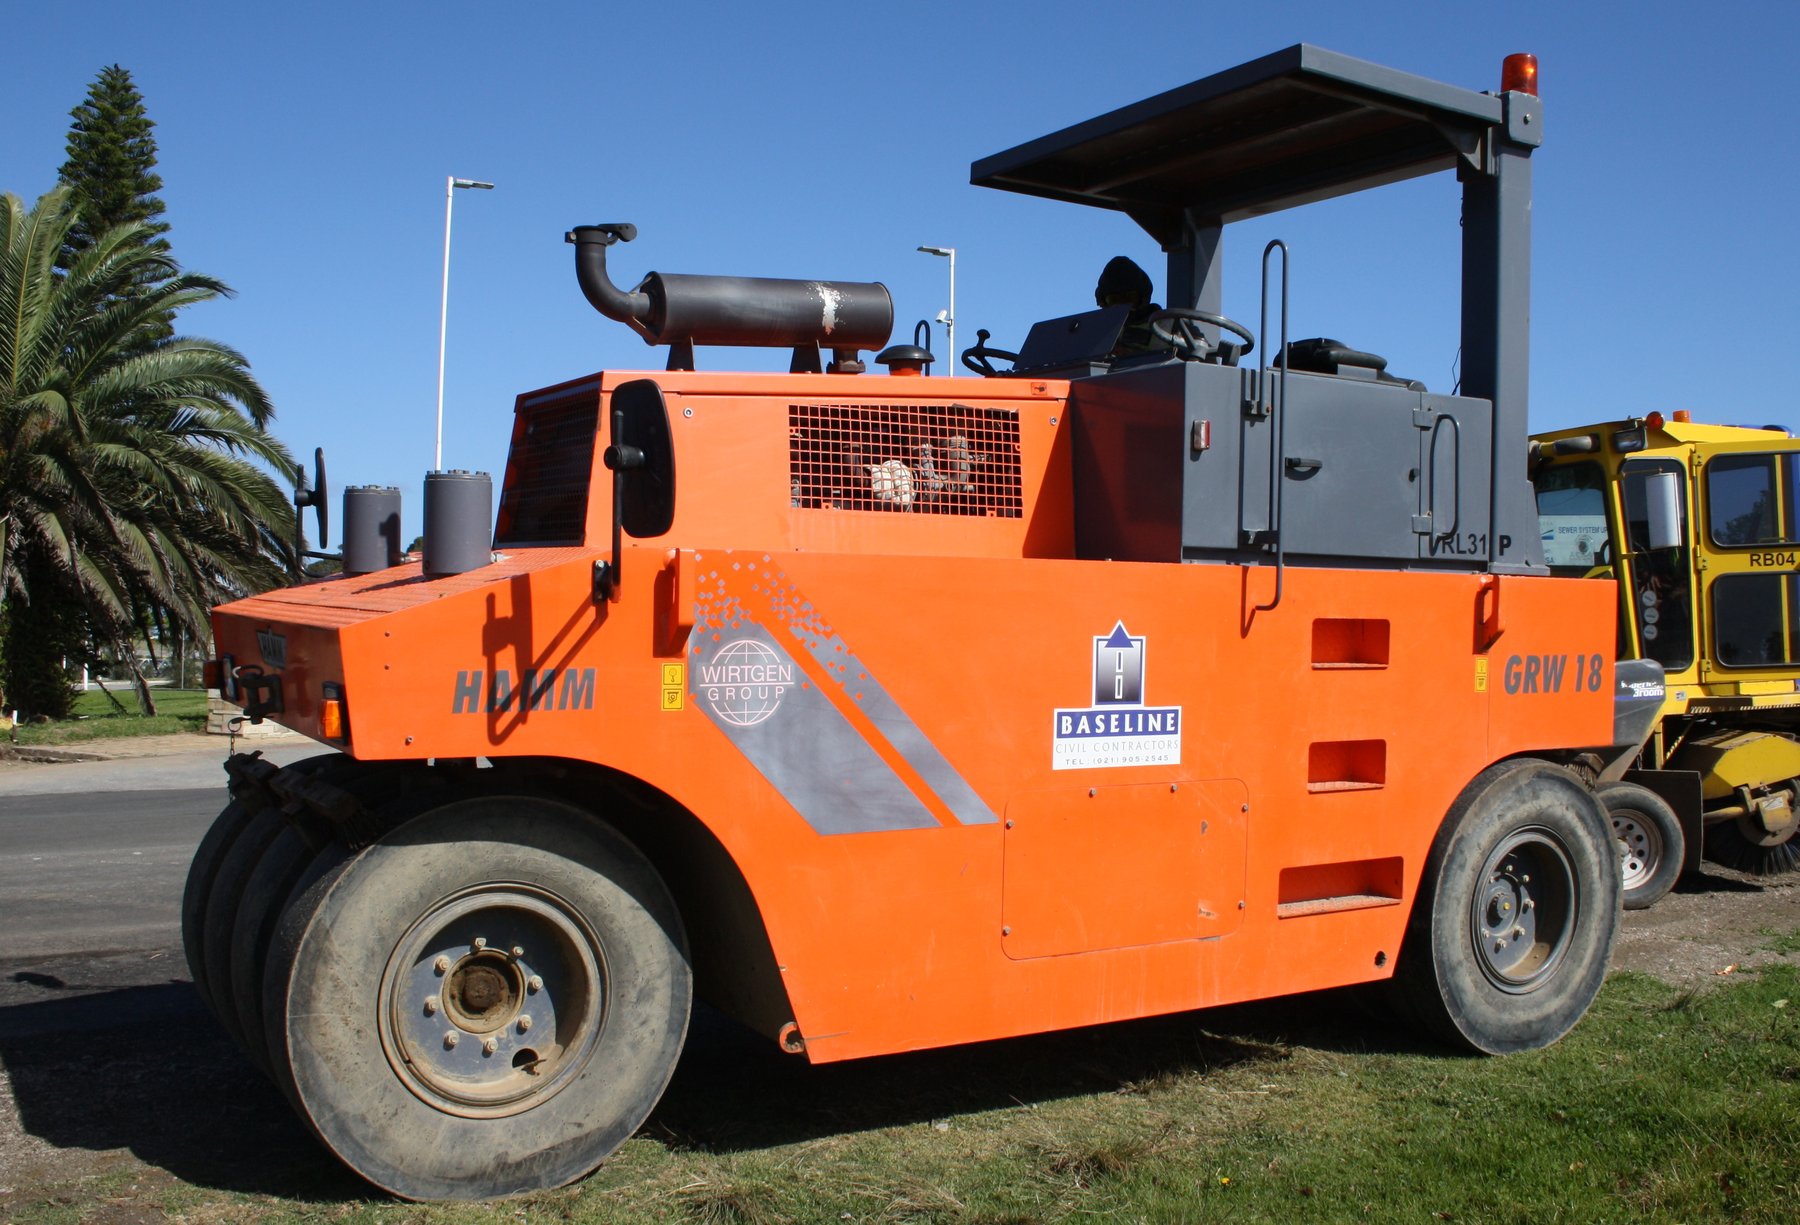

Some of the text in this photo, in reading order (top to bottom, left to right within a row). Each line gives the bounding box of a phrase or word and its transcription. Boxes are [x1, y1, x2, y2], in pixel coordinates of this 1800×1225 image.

[1750, 552, 1795, 567] RB04
[702, 664, 792, 684] WIRTGEN
[1504, 653, 1603, 695] GRW 18
[452, 668, 597, 714] HAMM
[708, 686, 785, 702] GROUP
[1061, 713, 1175, 735] BASELINE
[1055, 739, 1178, 754] CIVIL CONTRACTORS
